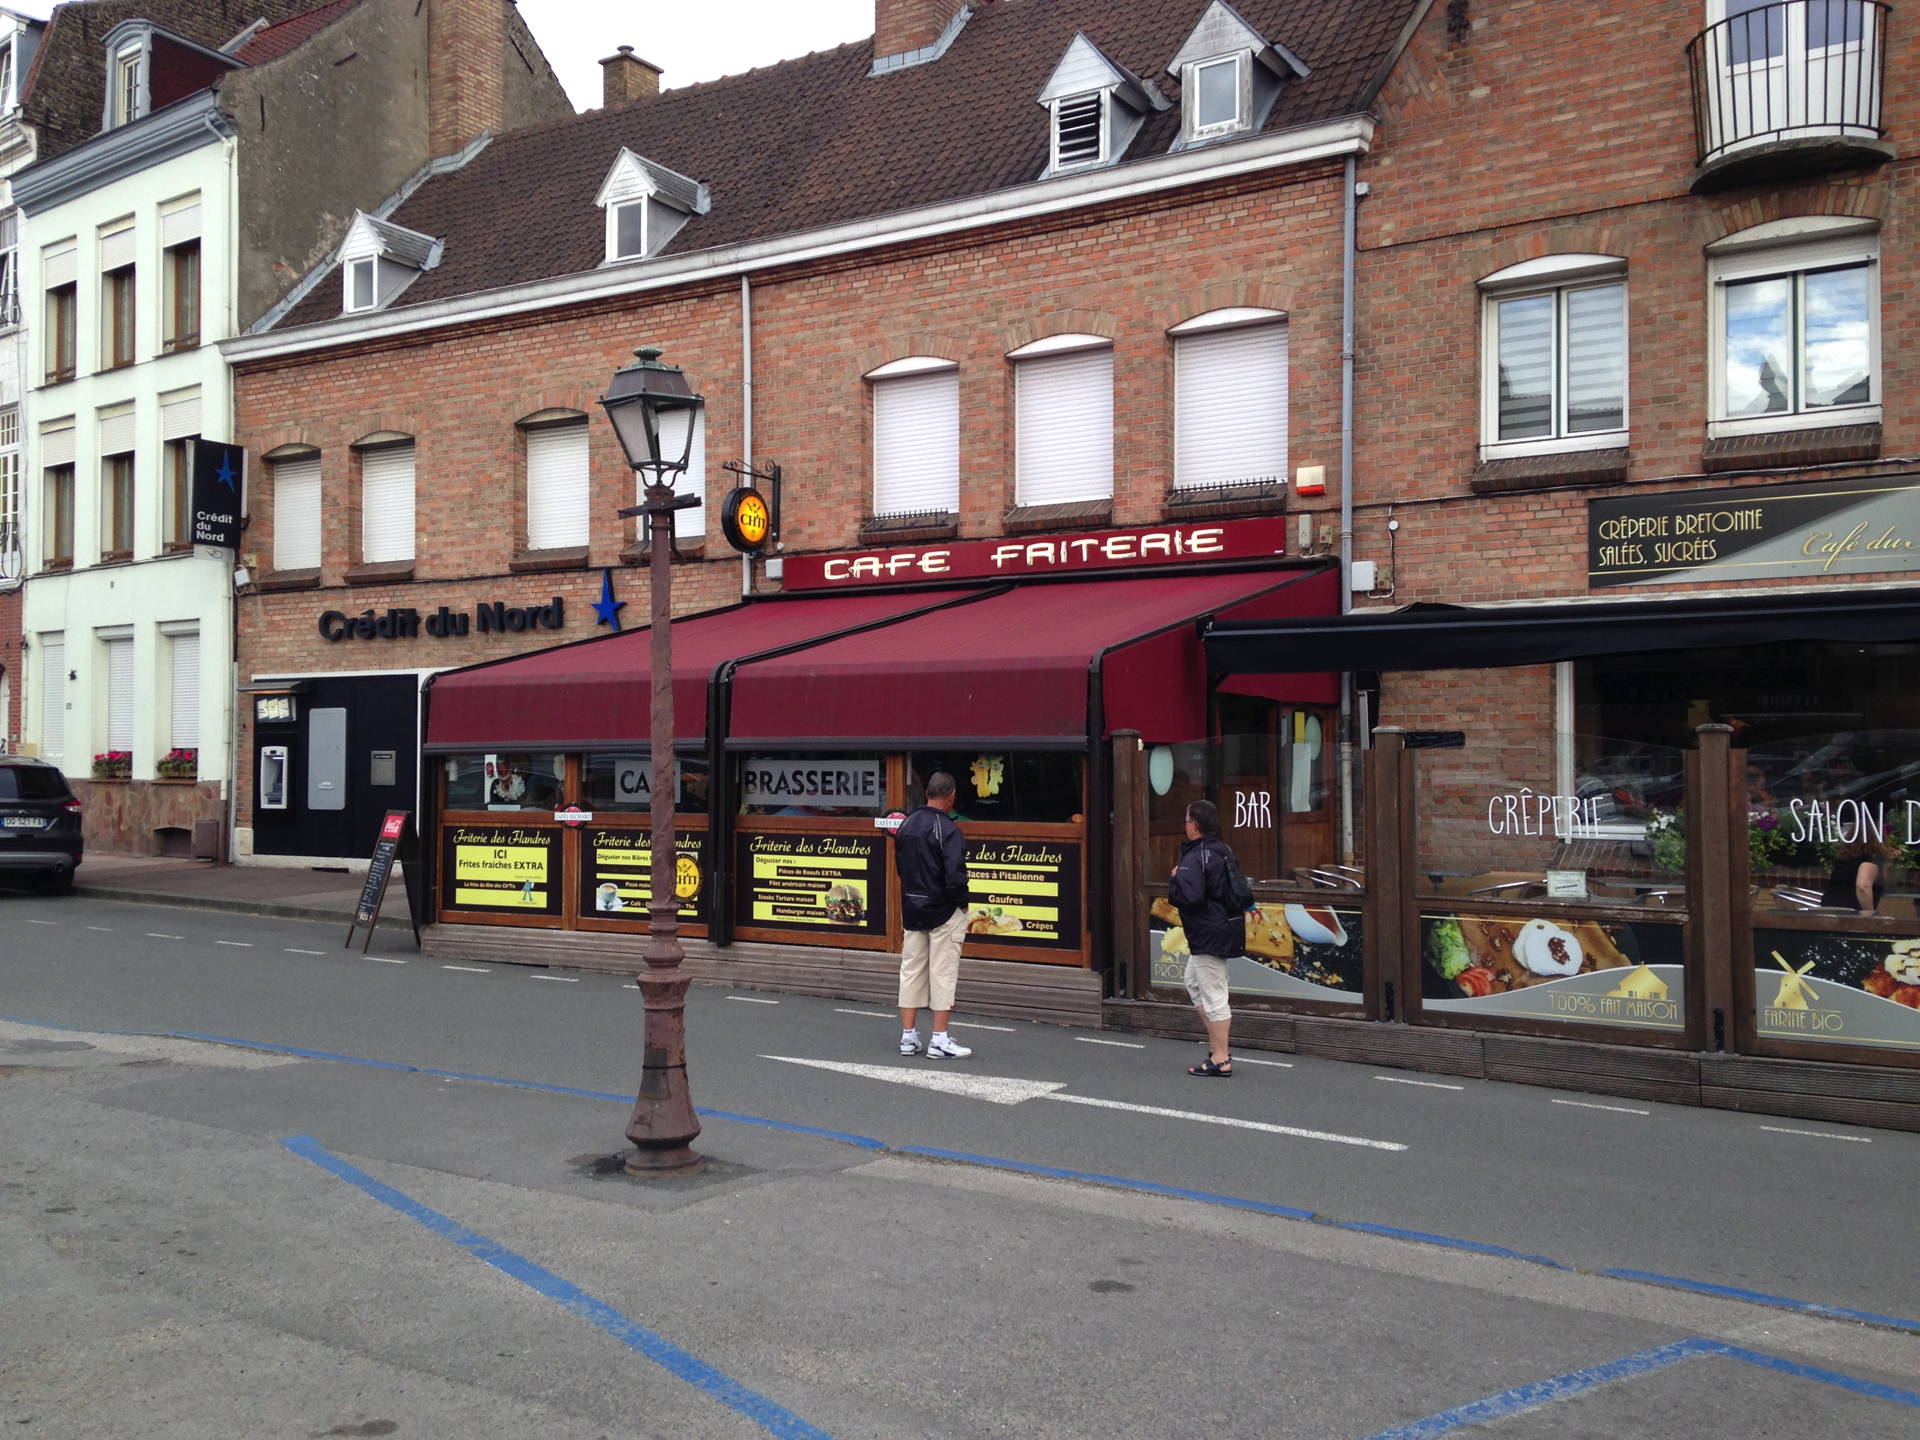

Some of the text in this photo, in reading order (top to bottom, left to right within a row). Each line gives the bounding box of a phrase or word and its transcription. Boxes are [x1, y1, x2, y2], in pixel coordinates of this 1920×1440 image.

[196, 511, 233, 524] Crédit
[196, 521, 211, 530] du
[1599, 509, 1763, 540] CRÊPERIE BRETONNE
[196, 530, 224, 542] Nord
[823, 528, 1224, 580] CAFE FRITERIE
[1598, 536, 1717, 567] SALÉES, SUCRÉES
[1802, 520, 1902, 571] Café du
[318, 597, 565, 641] Crédit du Nord
[745, 770, 875, 796] BRASSERIE
[1233, 791, 1272, 829] BAR
[1488, 787, 1608, 838] CRÊPERIE
[1790, 798, 1884, 843] SALON
[453, 828, 551, 845] Friterie des Flandres
[593, 831, 702, 849] Friterie des ndres
[750, 836, 871, 855] Friterie des Flandres
[493, 849, 508, 859] ICI
[975, 844, 996, 860] des
[1001, 845, 1062, 863] Flandres
[458, 859, 480, 868] Frites
[514, 861, 543, 870] EXTRA
[677, 873, 697, 885] H'TI
[967, 870, 1045, 881] laces à l'italienne
[988, 895, 1023, 905] Gaufres
[776, 908, 805, 916] Hamburger
[1026, 921, 1054, 931] Crêpes
[1154, 963, 1185, 978] PROD
[1549, 994, 1678, 1020] 100% FAIT MAISON
[1764, 1009, 1844, 1031] FARINE BIO
